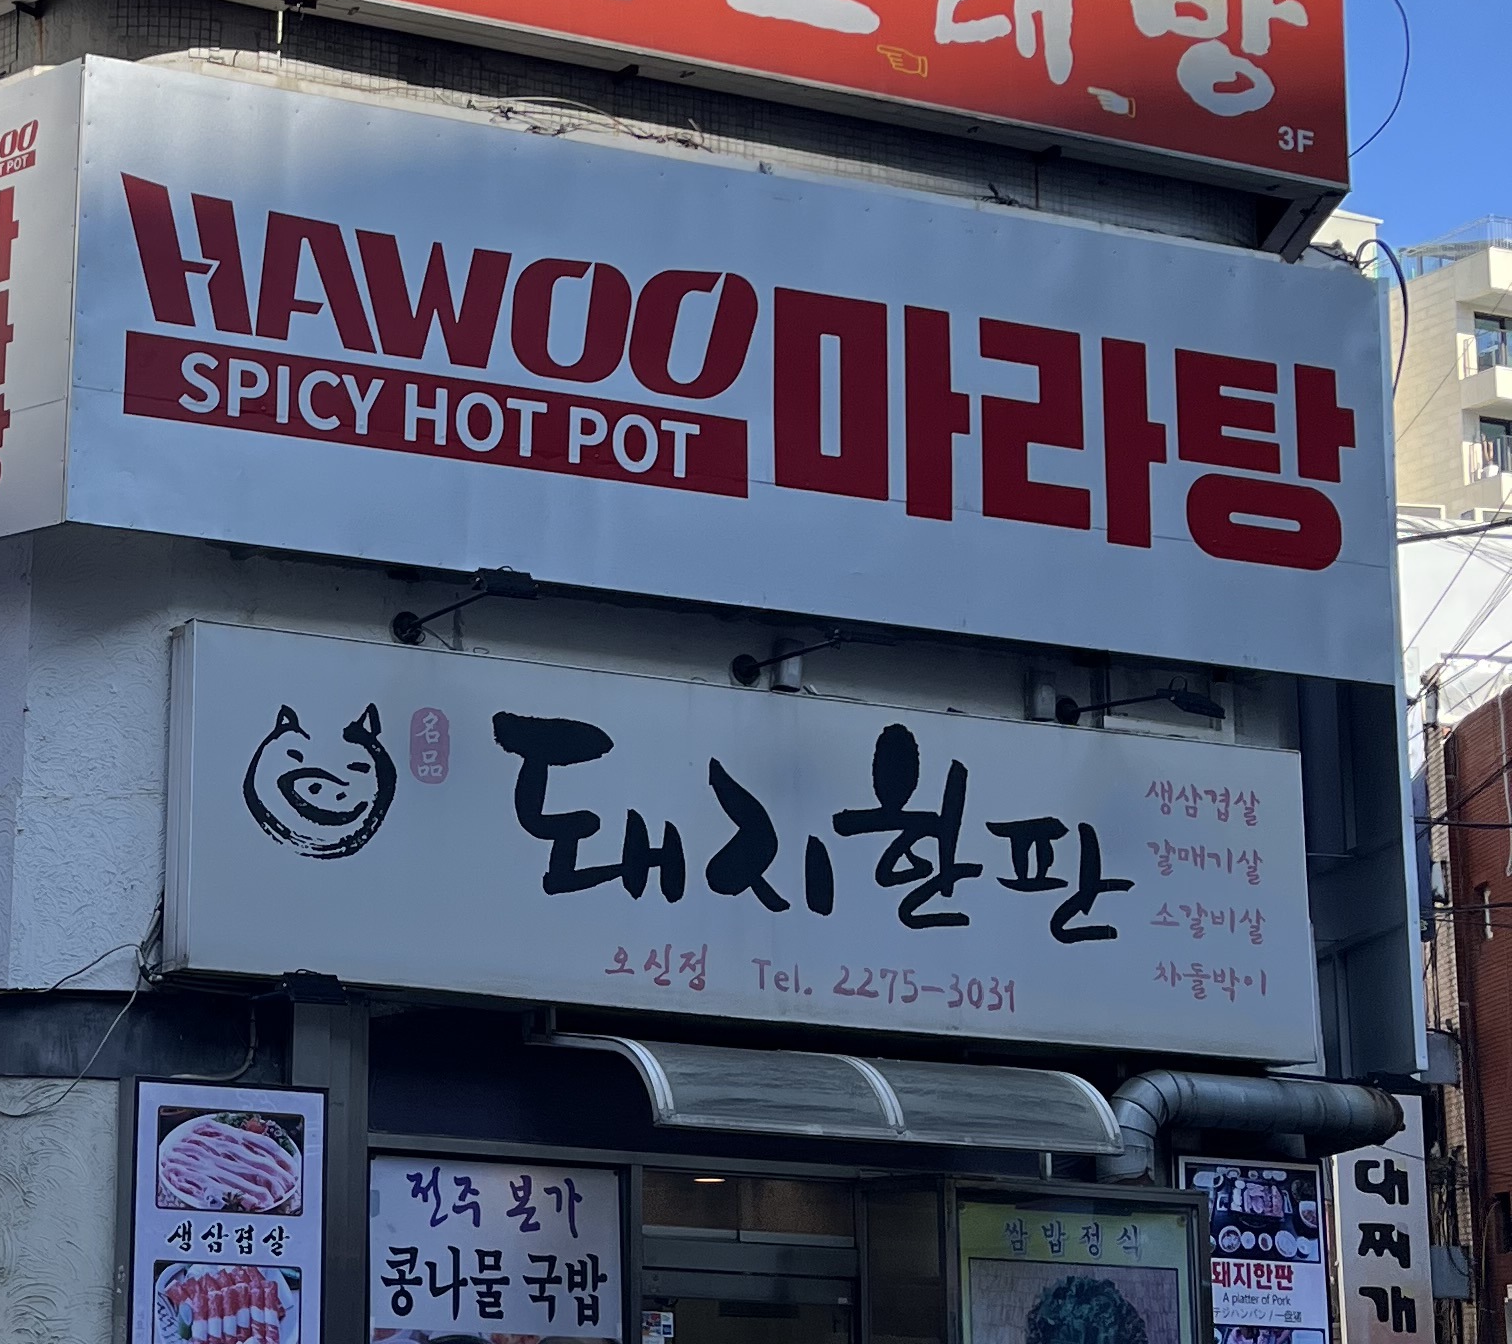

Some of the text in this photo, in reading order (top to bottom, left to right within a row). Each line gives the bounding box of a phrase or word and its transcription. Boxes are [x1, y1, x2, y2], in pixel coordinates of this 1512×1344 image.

[6, 154, 29, 173] POT
[1276, 127, 1315, 154] 3F
[122, 171, 760, 400] HAWOO
[179, 350, 702, 480] SPICY HOT POT
[772, 285, 1357, 571] 마라탕
[415, 711, 444, 777] 名品
[492, 710, 1135, 944] 돼지한판
[1145, 780, 1261, 826] 생삼겹살
[1147, 838, 1264, 886] 갈매기살
[1149, 902, 1266, 945] 소갈비살
[605, 944, 1015, 1013] 오신정 Tel. 2275-3031
[1154, 961, 1267, 1003] 차돌박이
[406, 1166, 583, 1239] 전주 본가
[167, 1220, 290, 1256] 생삼겹살
[1005, 1217, 1145, 1260] 쌈밥정식
[1353, 1157, 1416, 1336] 대찌개
[381, 1245, 607, 1327] 콩나물 국밥
[1212, 1260, 1294, 1291] 돼지한판
[1222, 1293, 1292, 1306] A platter of Pork
